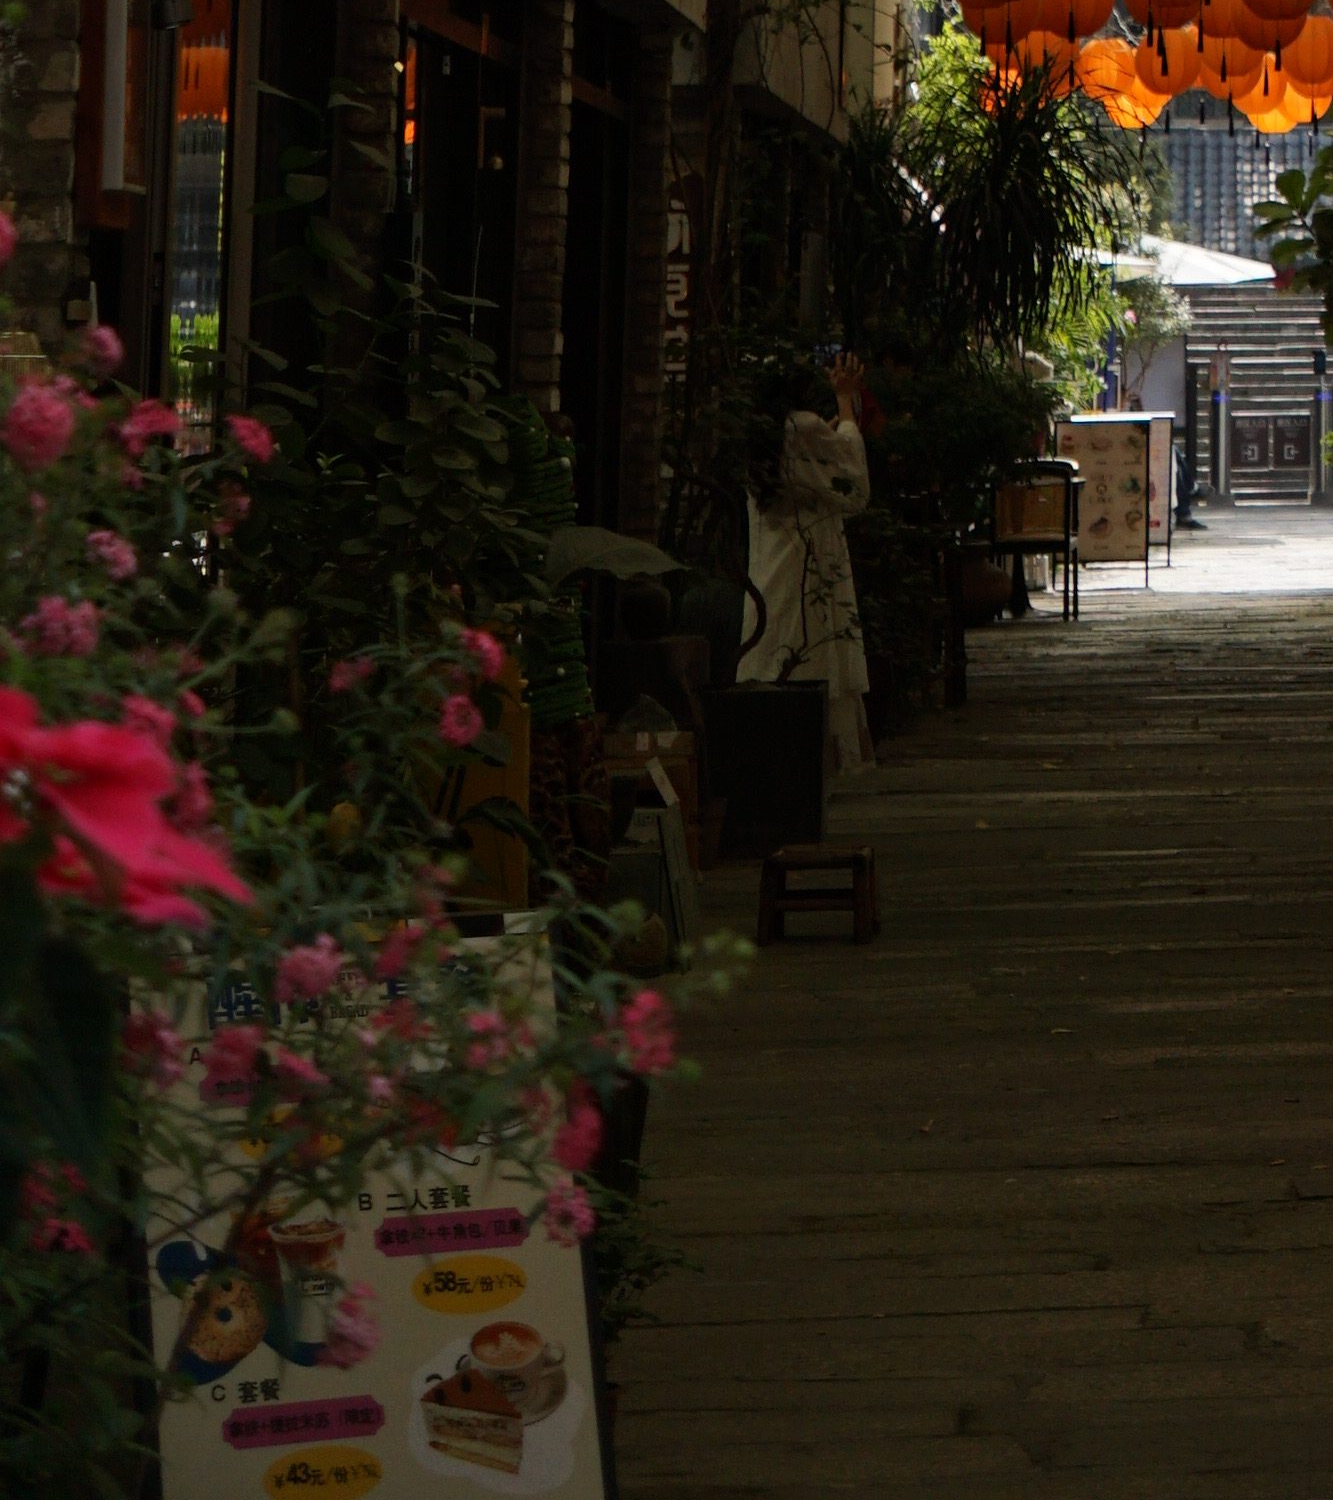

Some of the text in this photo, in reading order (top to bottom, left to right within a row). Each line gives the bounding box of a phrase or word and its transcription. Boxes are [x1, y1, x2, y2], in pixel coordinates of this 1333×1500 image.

[358, 1185, 471, 1211] B 二人套餐
[211, 1378, 280, 1403] C 套餐
